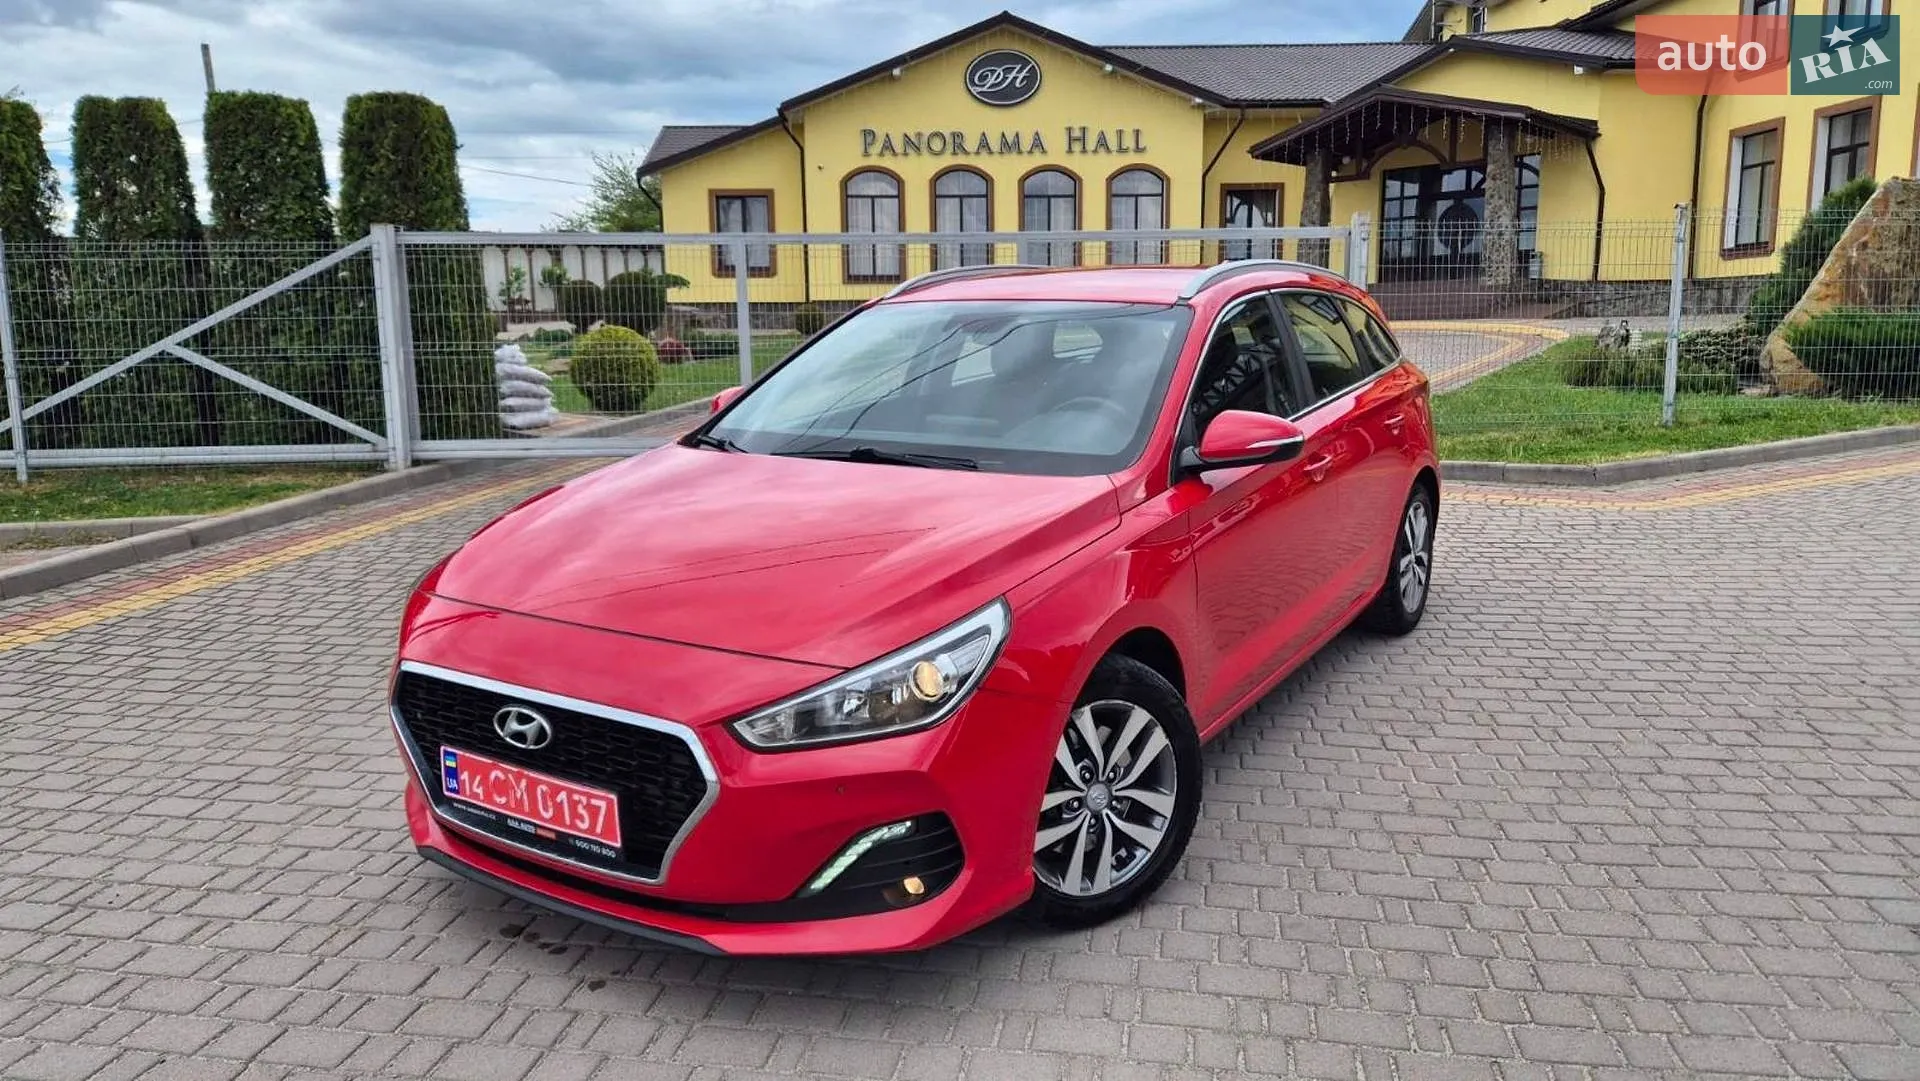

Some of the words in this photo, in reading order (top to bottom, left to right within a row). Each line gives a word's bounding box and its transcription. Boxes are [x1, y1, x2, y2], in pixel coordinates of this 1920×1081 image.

[859, 128, 1048, 157] PANORAMA
[1065, 125, 1147, 154] HALL
[446, 777, 459, 790] UA
